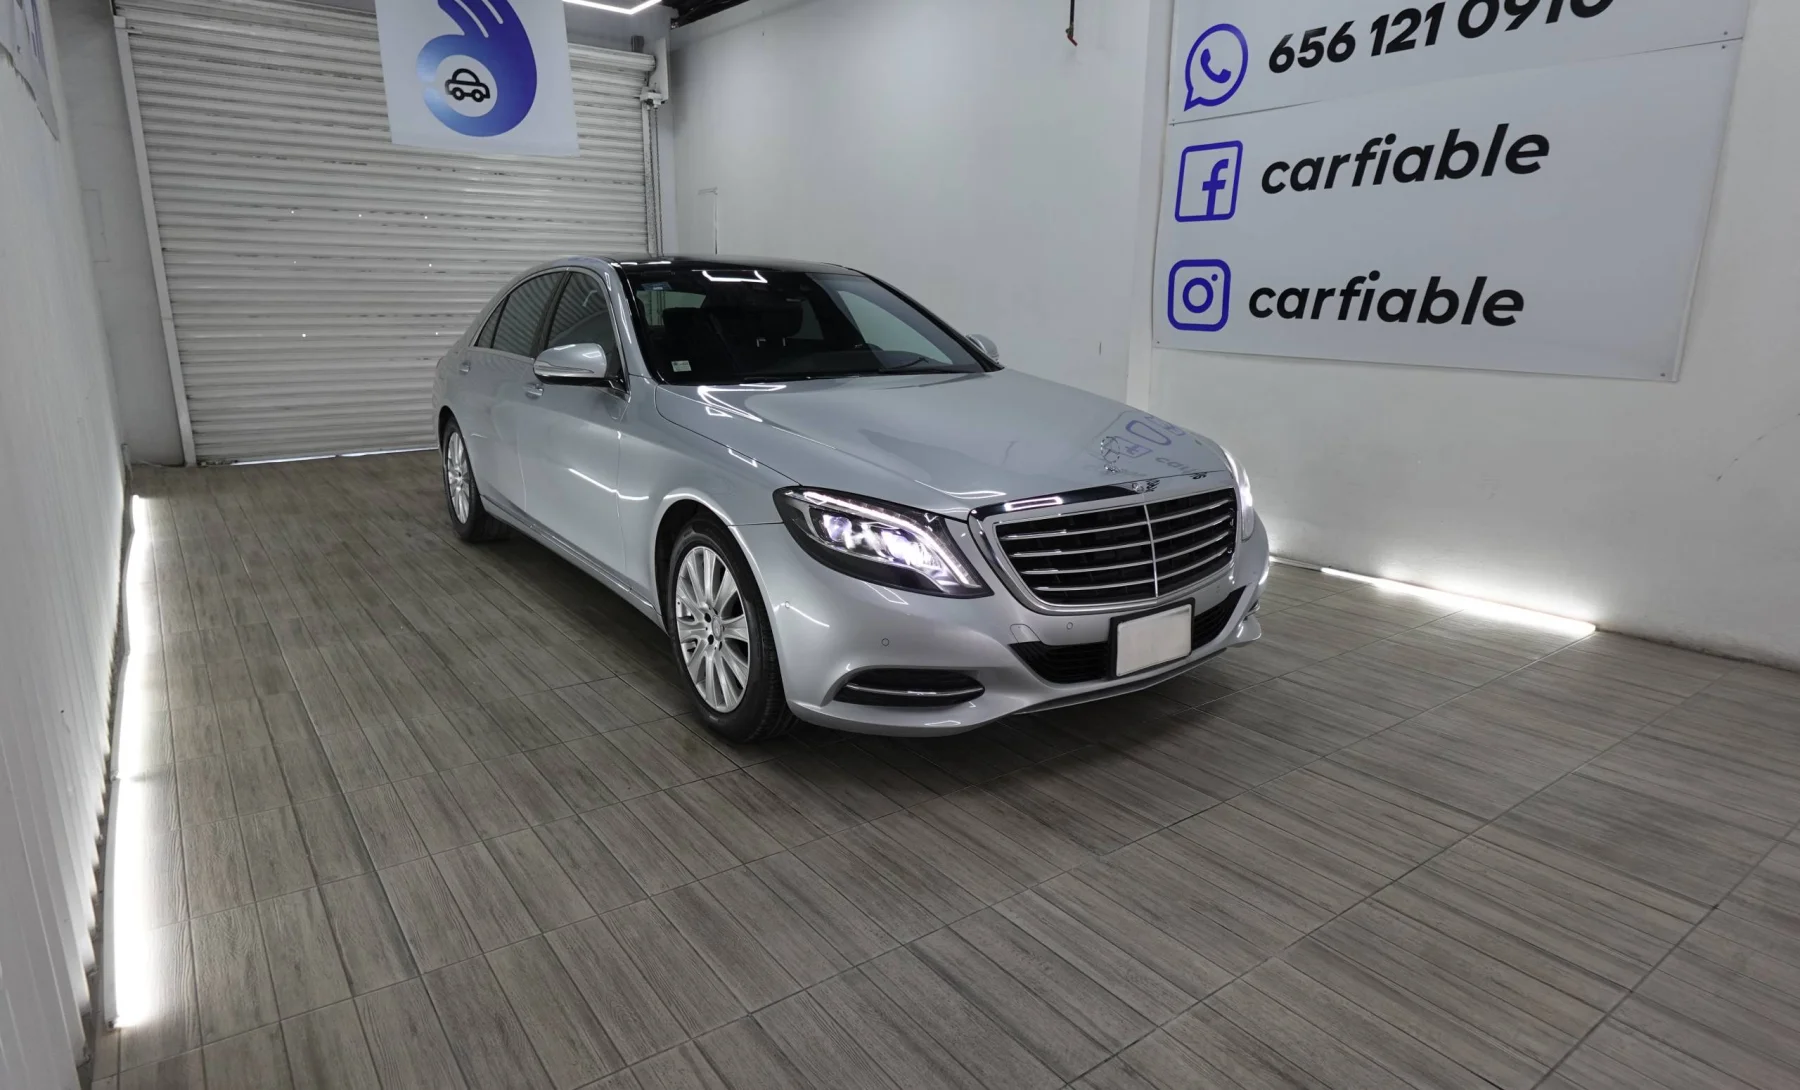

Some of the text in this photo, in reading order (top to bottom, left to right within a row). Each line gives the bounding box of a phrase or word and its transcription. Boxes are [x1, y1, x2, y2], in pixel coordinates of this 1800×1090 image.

[1268, 20, 1356, 74] 656
[1370, 1, 1446, 57] 121
[1261, 123, 1550, 195] carfiable
[1249, 270, 1525, 327] carfiable
